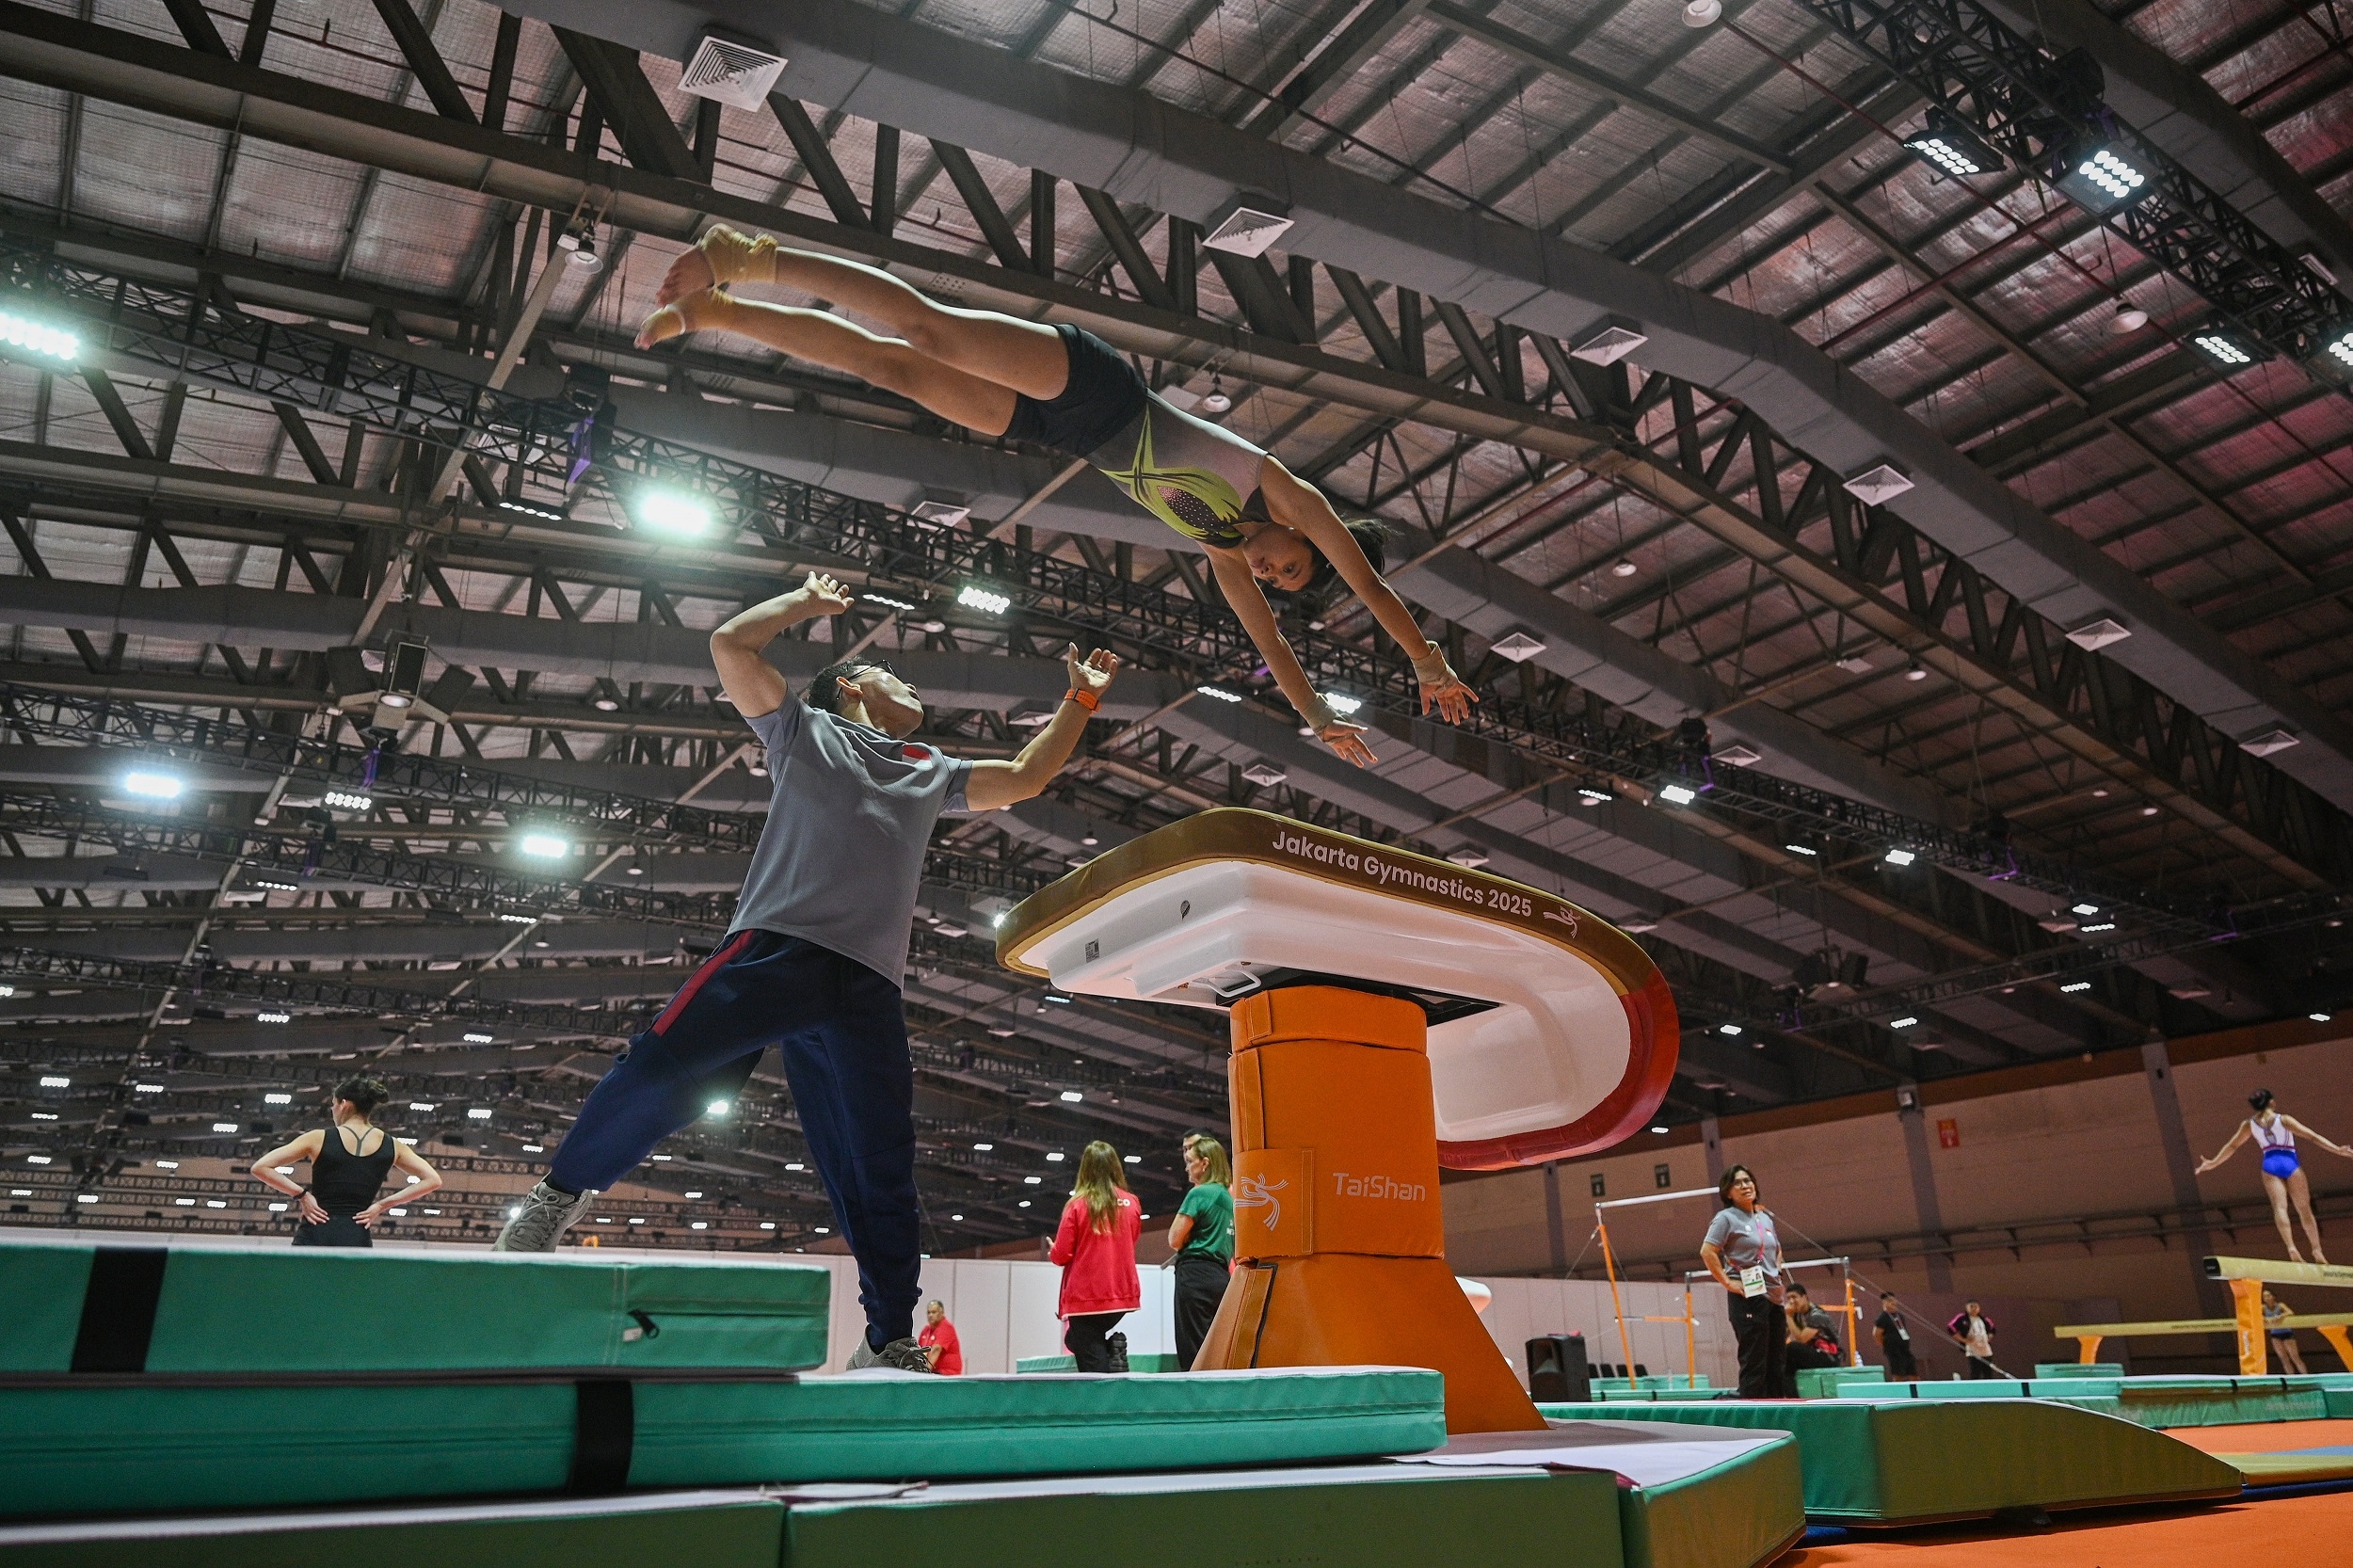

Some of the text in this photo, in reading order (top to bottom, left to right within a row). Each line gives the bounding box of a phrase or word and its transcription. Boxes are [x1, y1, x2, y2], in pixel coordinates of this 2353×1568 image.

[1272, 831, 1532, 917] Jakarta Gymnastics 2025
[1332, 1172, 1426, 1202] TaiShan
